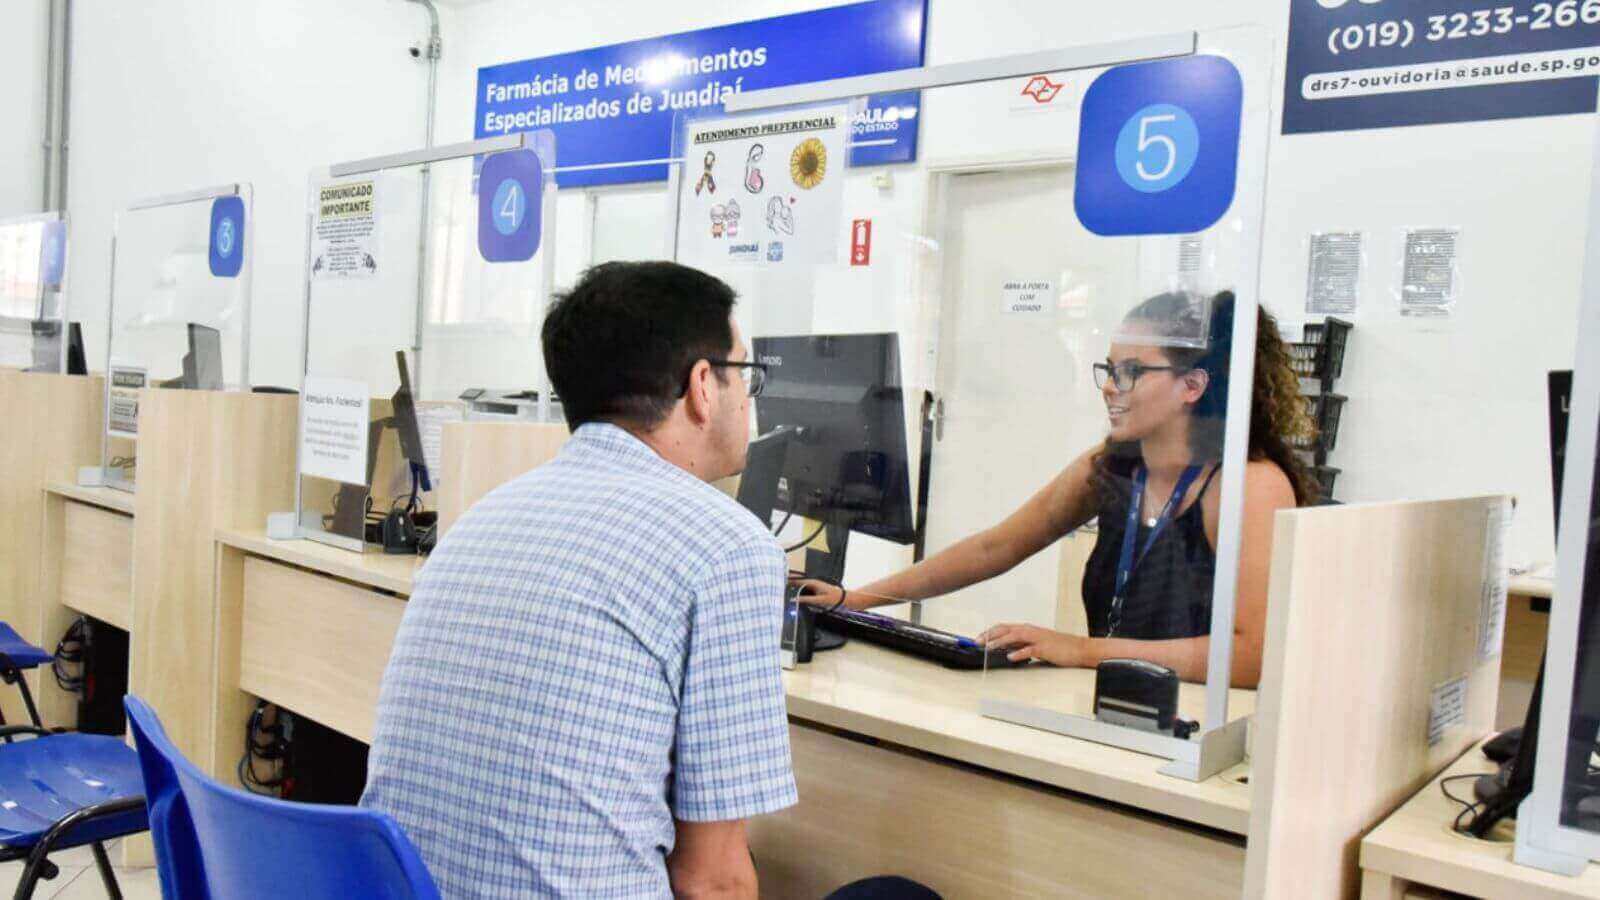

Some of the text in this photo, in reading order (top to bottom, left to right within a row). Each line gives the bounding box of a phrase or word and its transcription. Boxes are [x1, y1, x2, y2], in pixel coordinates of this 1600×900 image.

[1328, 20, 1414, 54] (019)
[486, 74, 569, 103] Farmácia
[574, 69, 599, 91] de
[484, 98, 621, 134] Especializados
[626, 92, 652, 115] de
[694, 116, 836, 143] ATENDIMENTO PREFERENCIAL
[1135, 114, 1176, 181] 5
[320, 184, 373, 201] COMUNICADO
[321, 200, 371, 216] IMPORTANTE
[500, 185, 517, 227] 4
[220, 221, 232, 253] 3
